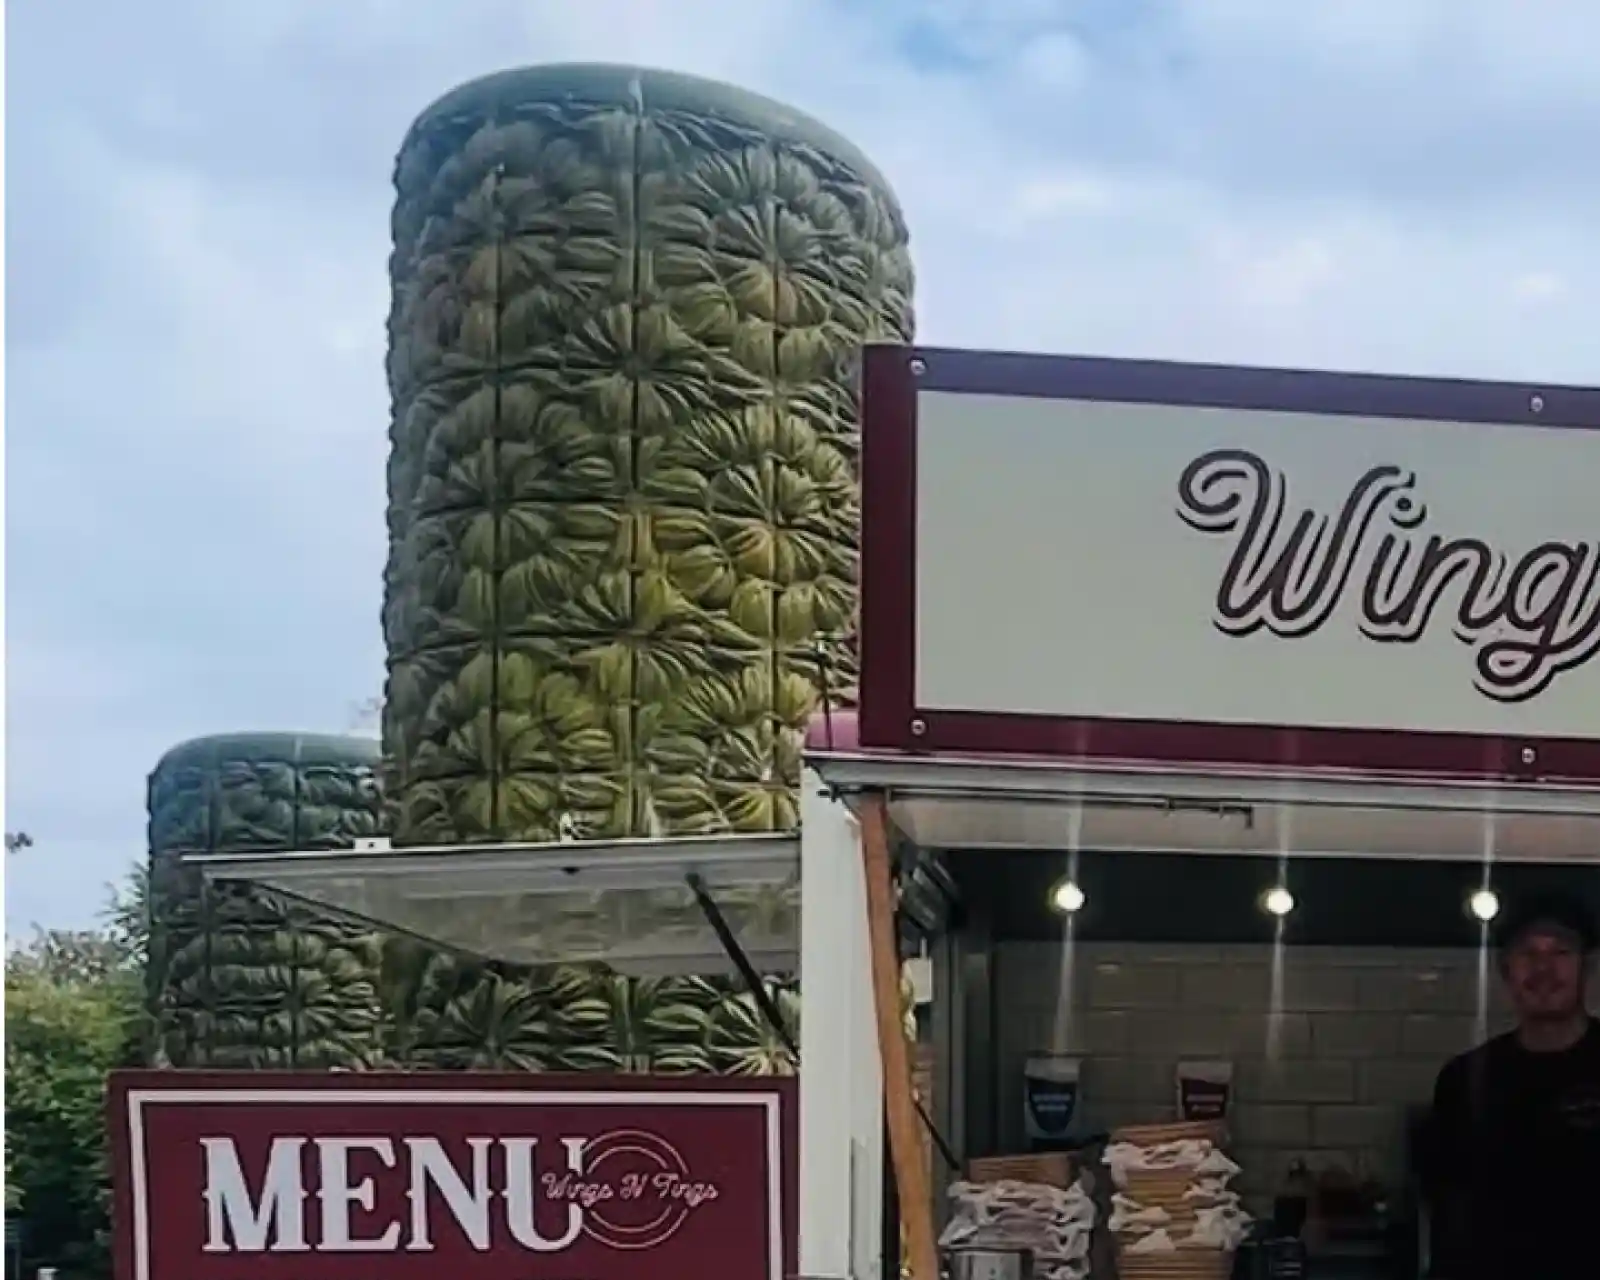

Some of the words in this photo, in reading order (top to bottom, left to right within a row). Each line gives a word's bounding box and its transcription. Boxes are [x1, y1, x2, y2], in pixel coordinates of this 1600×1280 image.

[200, 1137, 589, 1252] MENU
[541, 1172, 614, 1207] Wings
[619, 1172, 649, 1199] N
[652, 1172, 719, 1207] Tings
